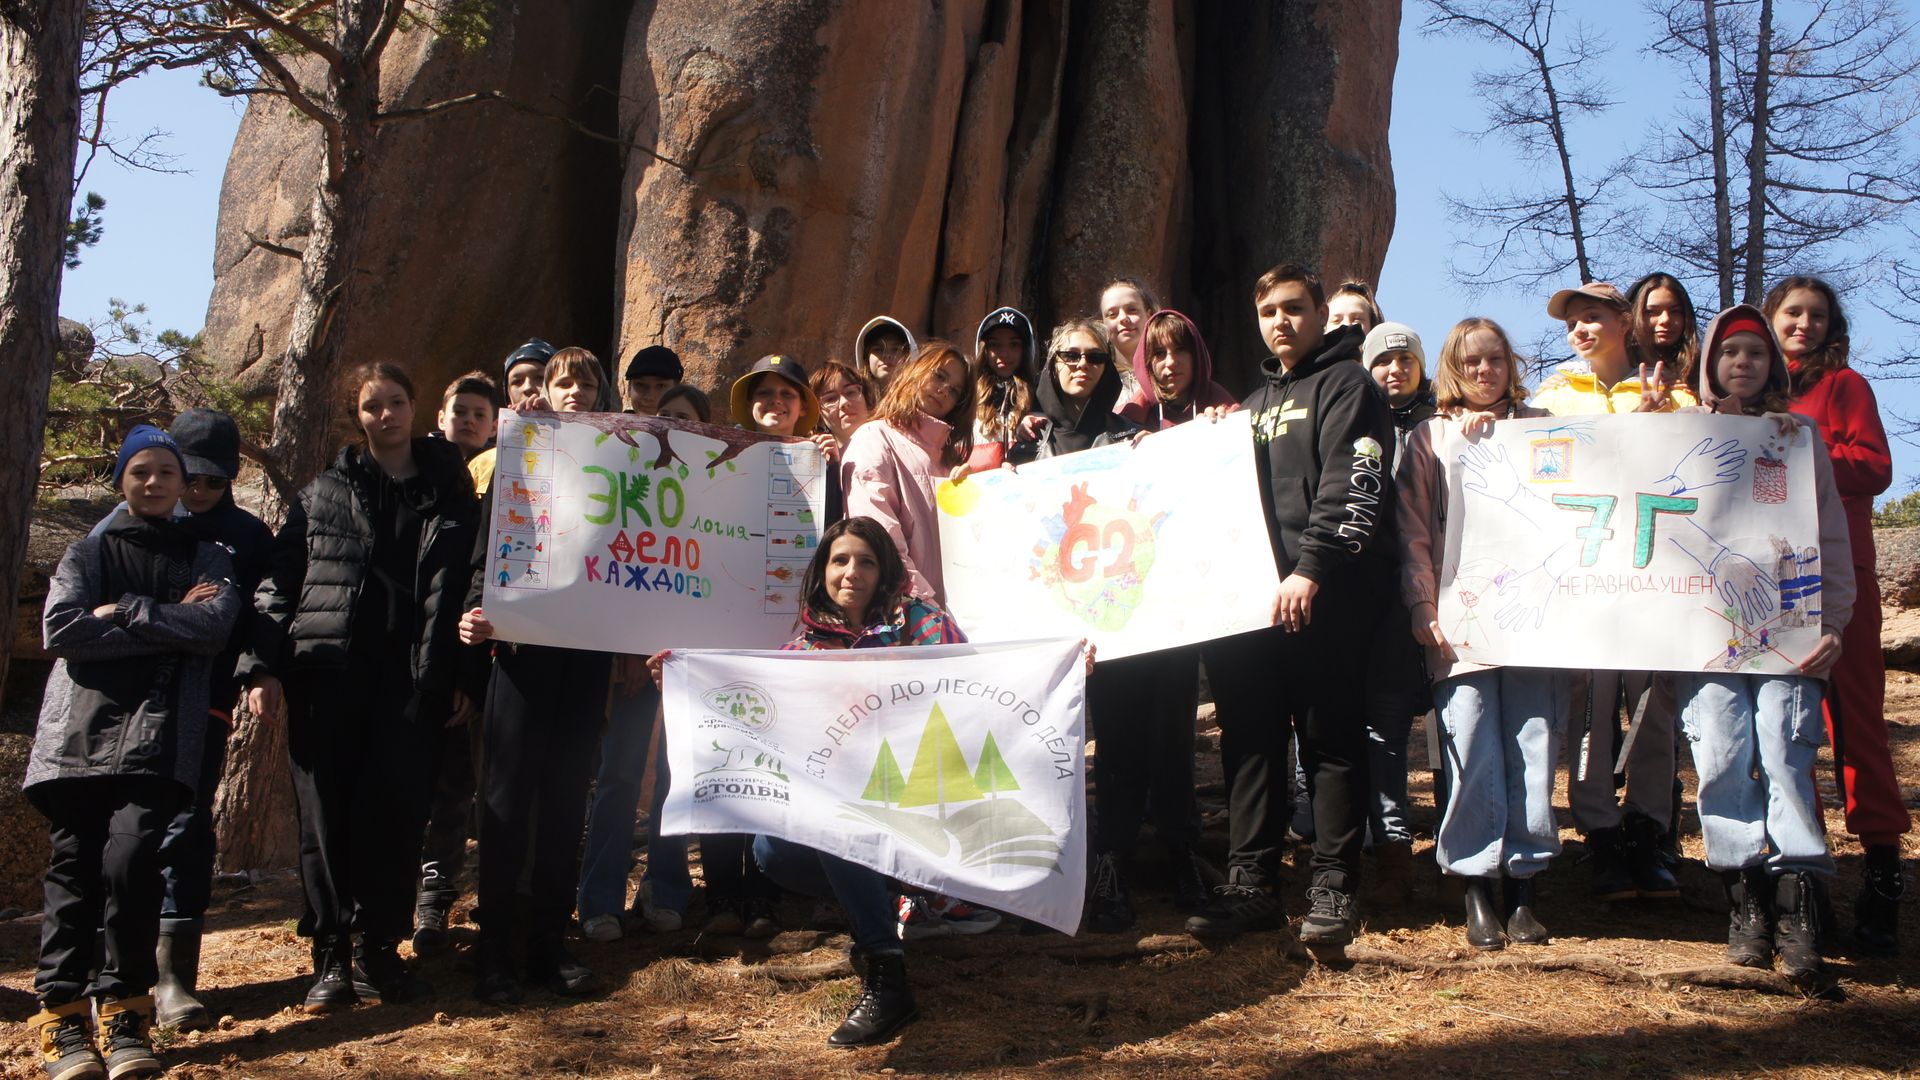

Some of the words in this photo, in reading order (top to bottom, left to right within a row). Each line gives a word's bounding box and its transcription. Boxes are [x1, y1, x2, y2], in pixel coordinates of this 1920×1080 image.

[582, 465, 685, 528] ЭКО
[584, 555, 711, 598] КАЖДОГО
[825, 694, 882, 746] ДЕЛО
[890, 680, 925, 705] ДО
[933, 678, 1041, 726] ЛЕСНОГО
[1032, 725, 1074, 780] ДЕЛА
[694, 783, 791, 802] СТОЛБЫ
